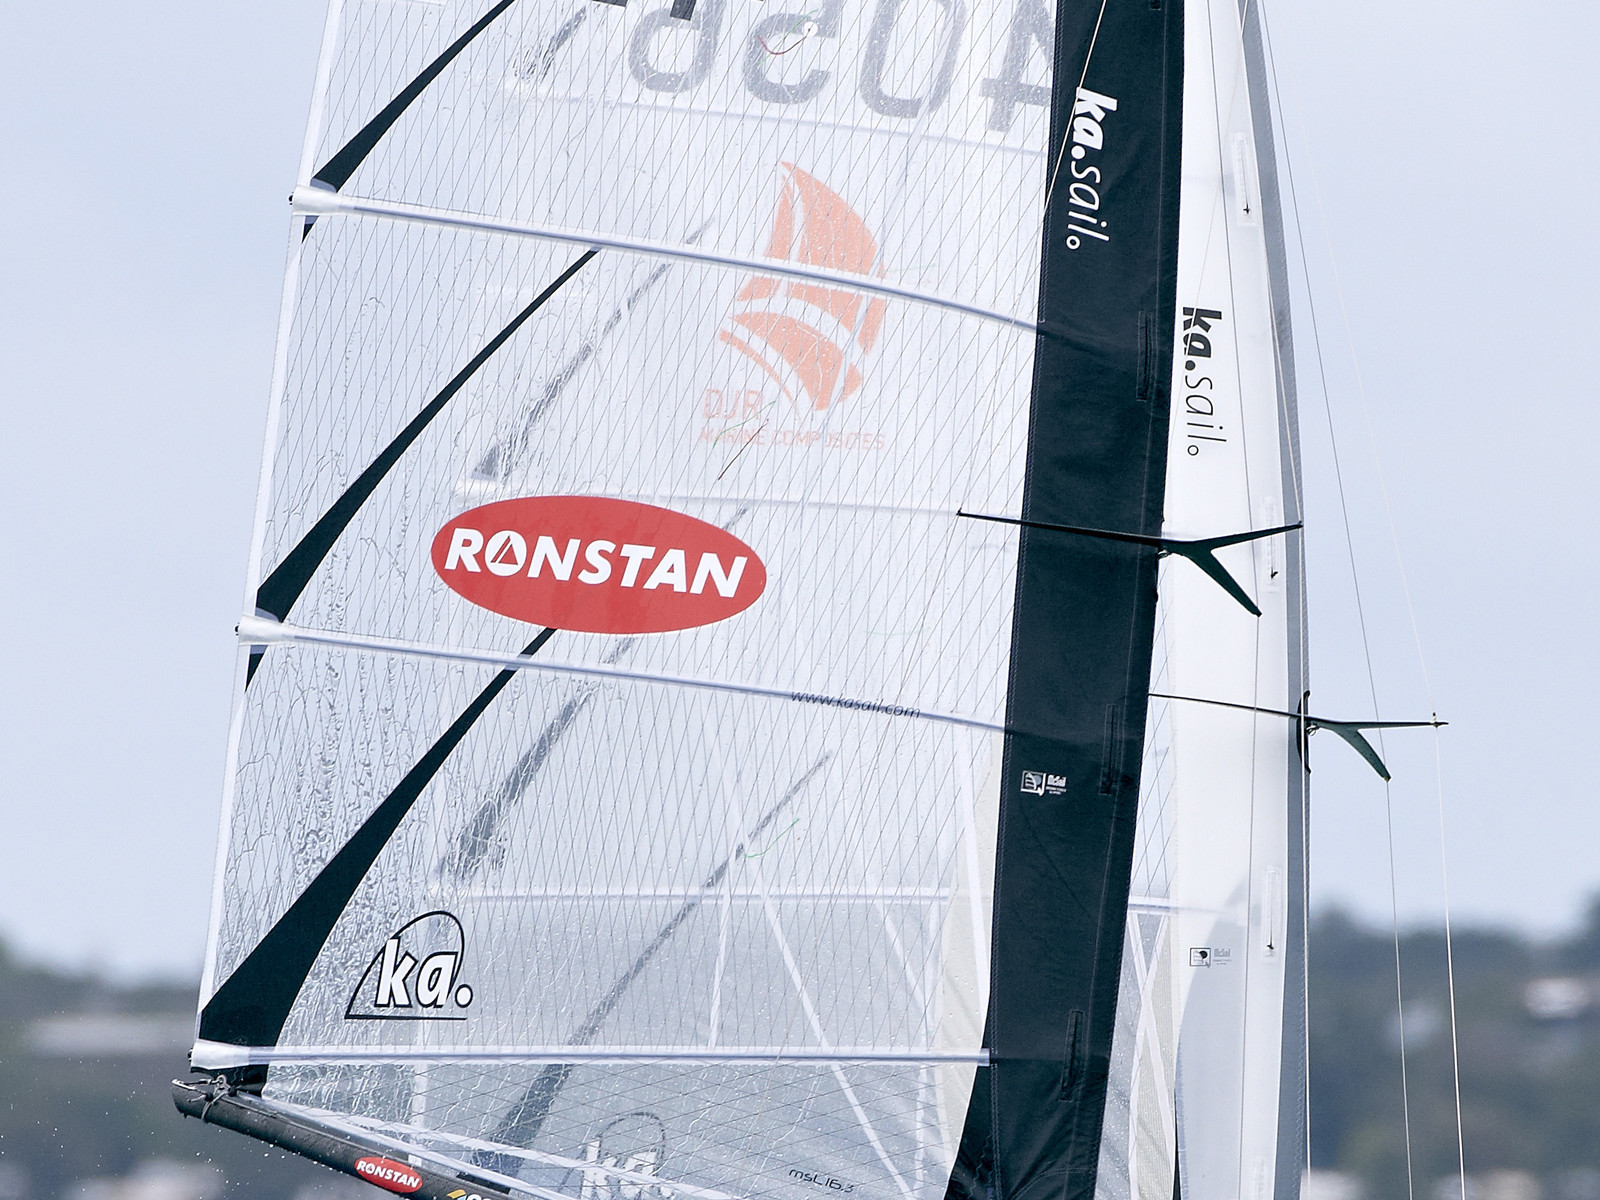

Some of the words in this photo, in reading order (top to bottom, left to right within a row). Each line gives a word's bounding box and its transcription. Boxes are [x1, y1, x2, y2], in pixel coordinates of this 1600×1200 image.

[444, 527, 748, 598] RONSTAN
[791, 691, 921, 719] www.kasail.com
[355, 1160, 420, 1188] RONSTAN
